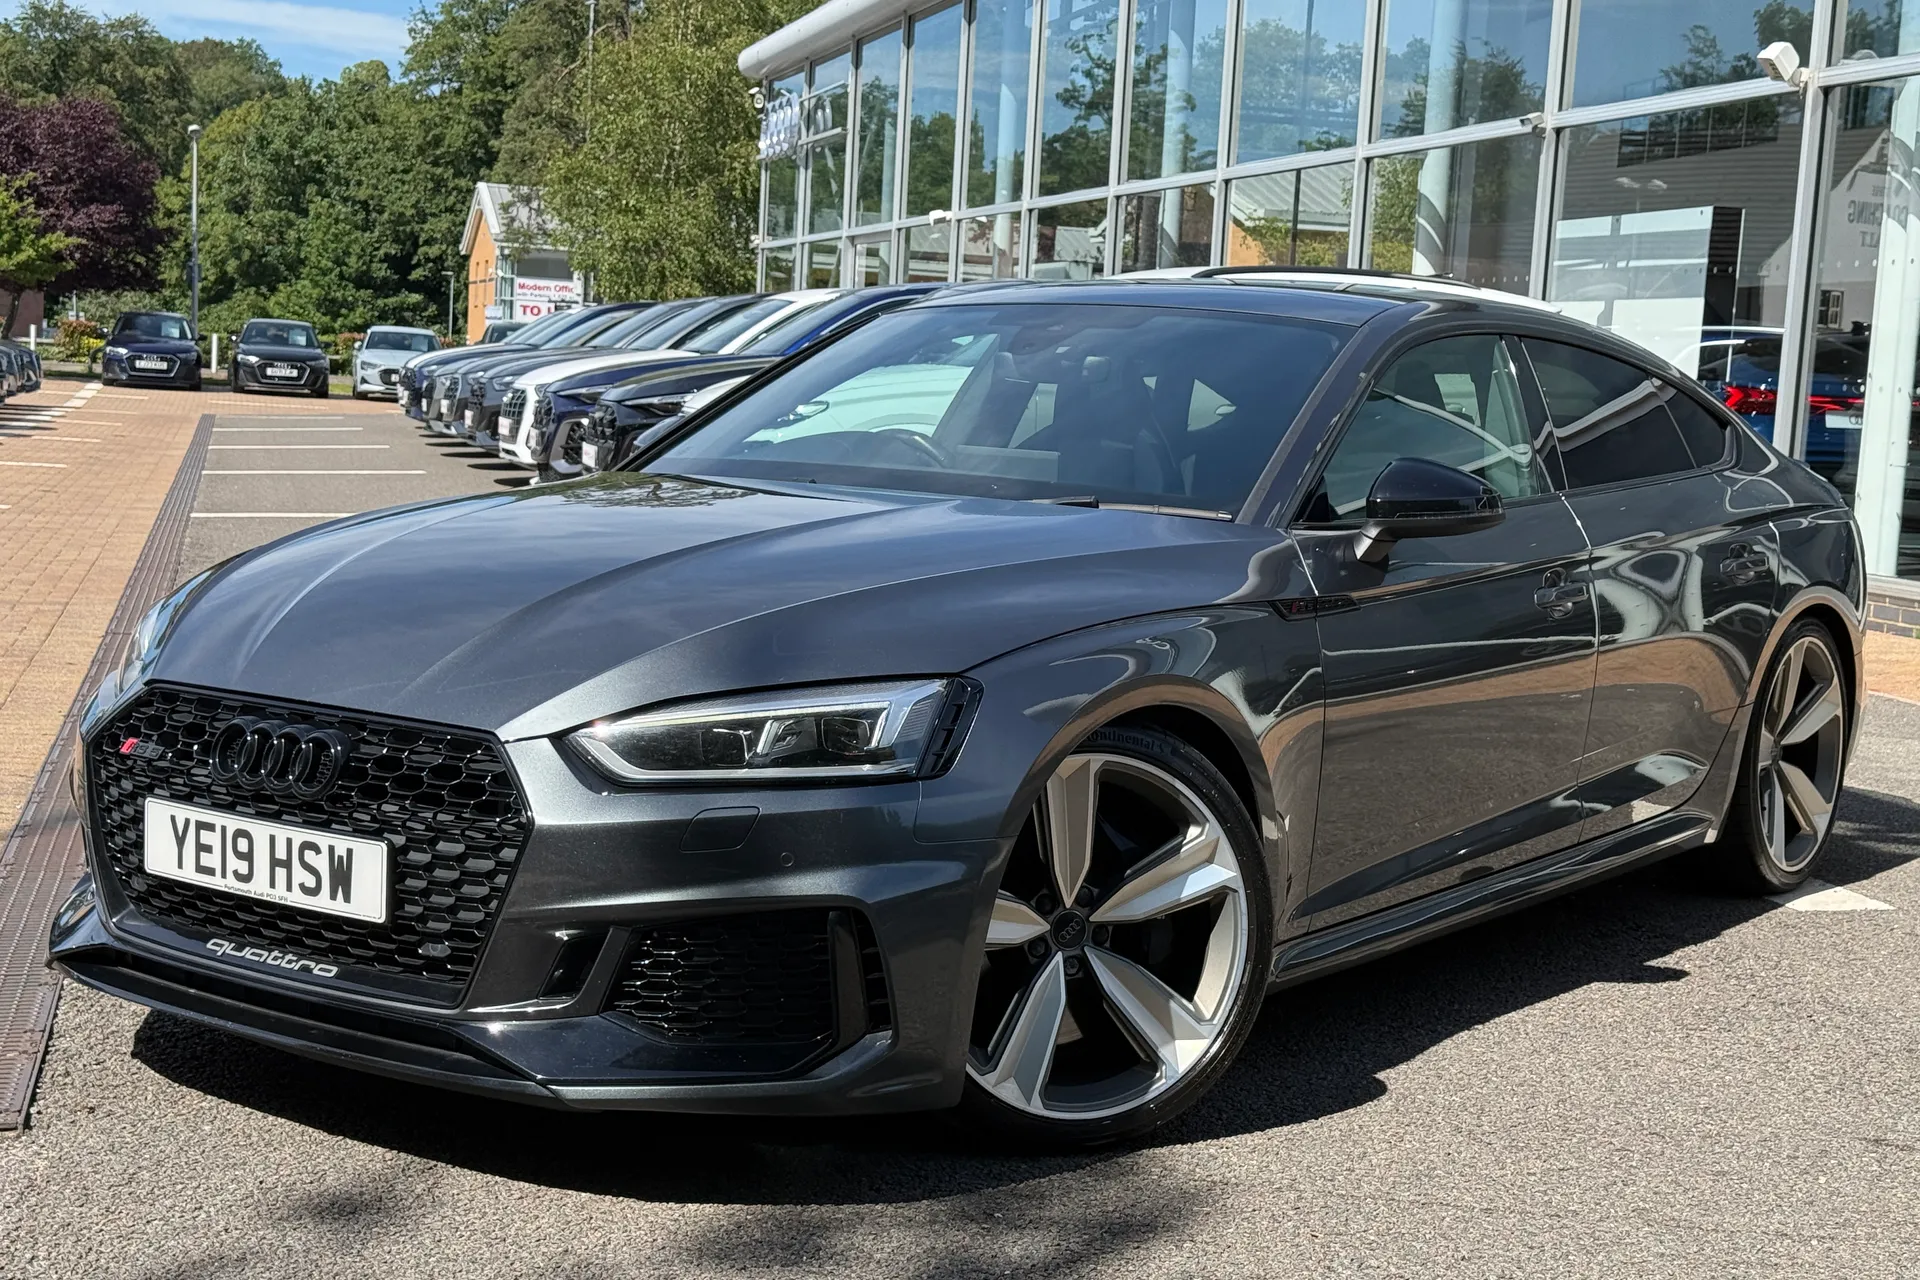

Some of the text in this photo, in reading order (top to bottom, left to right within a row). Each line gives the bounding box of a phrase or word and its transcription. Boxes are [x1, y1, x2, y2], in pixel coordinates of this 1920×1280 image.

[518, 282, 552, 292] Modern
[519, 304, 542, 317] TO
[170, 814, 354, 904] YE19 HSW
[205, 937, 340, 979] quattro
